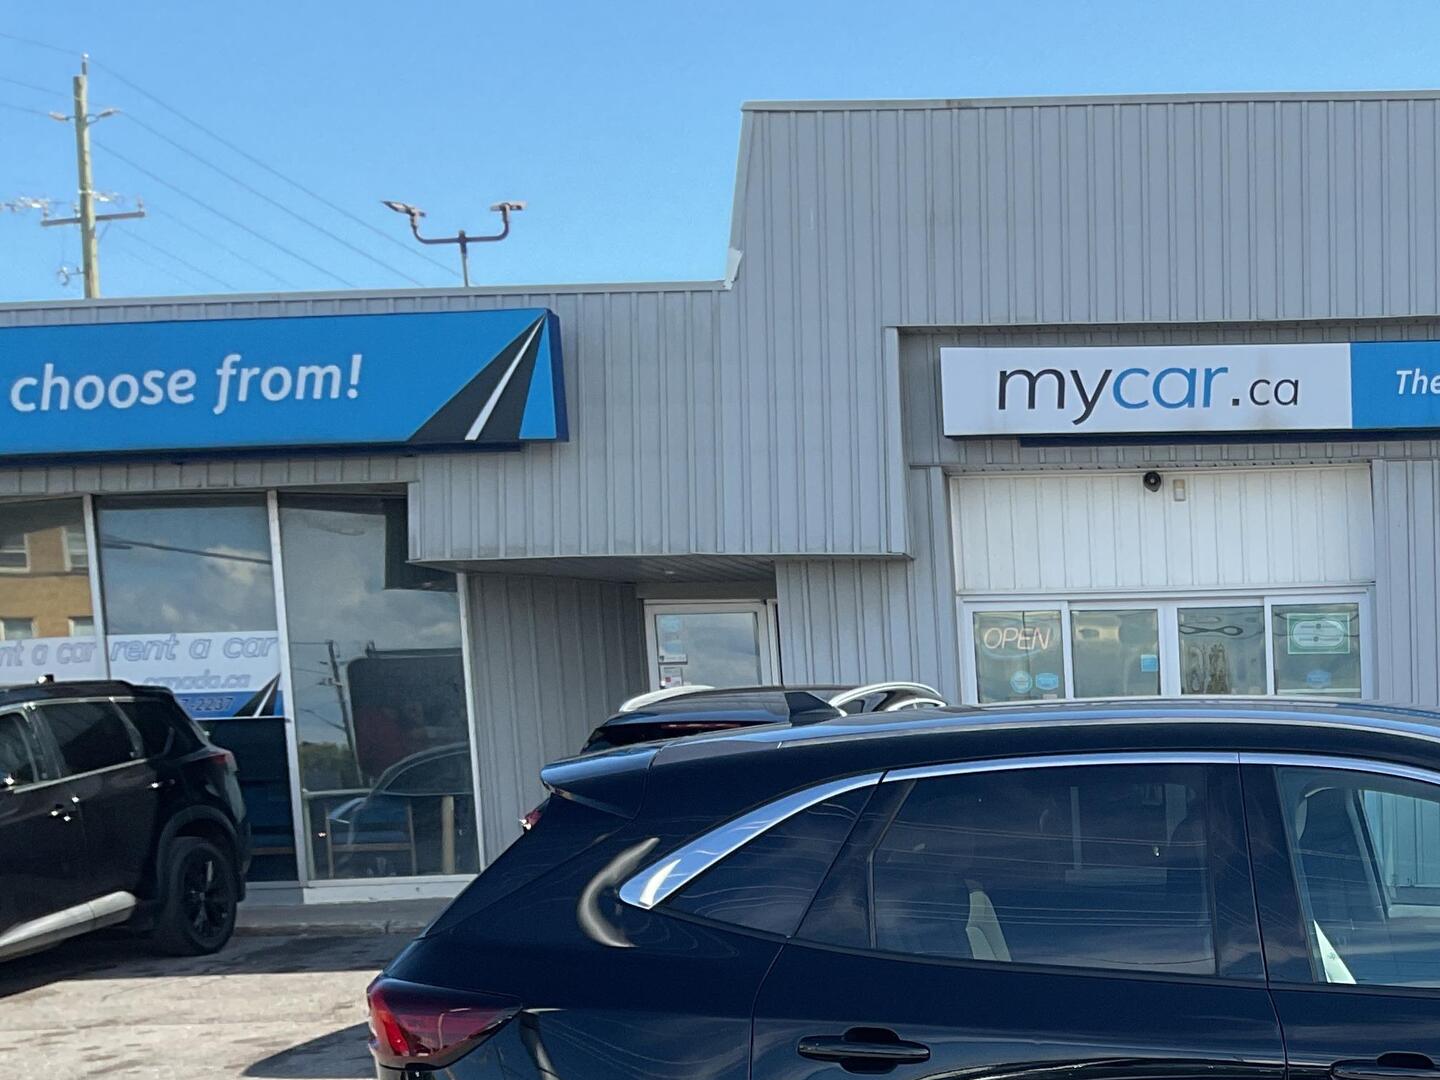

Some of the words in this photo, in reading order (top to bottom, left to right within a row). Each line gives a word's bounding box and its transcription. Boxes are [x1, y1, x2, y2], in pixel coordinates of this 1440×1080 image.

[10, 362, 198, 413] choose
[212, 353, 363, 415] from!
[997, 366, 1300, 426] mycar.ca
[109, 633, 180, 663] rent
[188, 637, 212, 660] a
[222, 636, 279, 659] car
[983, 626, 1051, 650] OPEN
